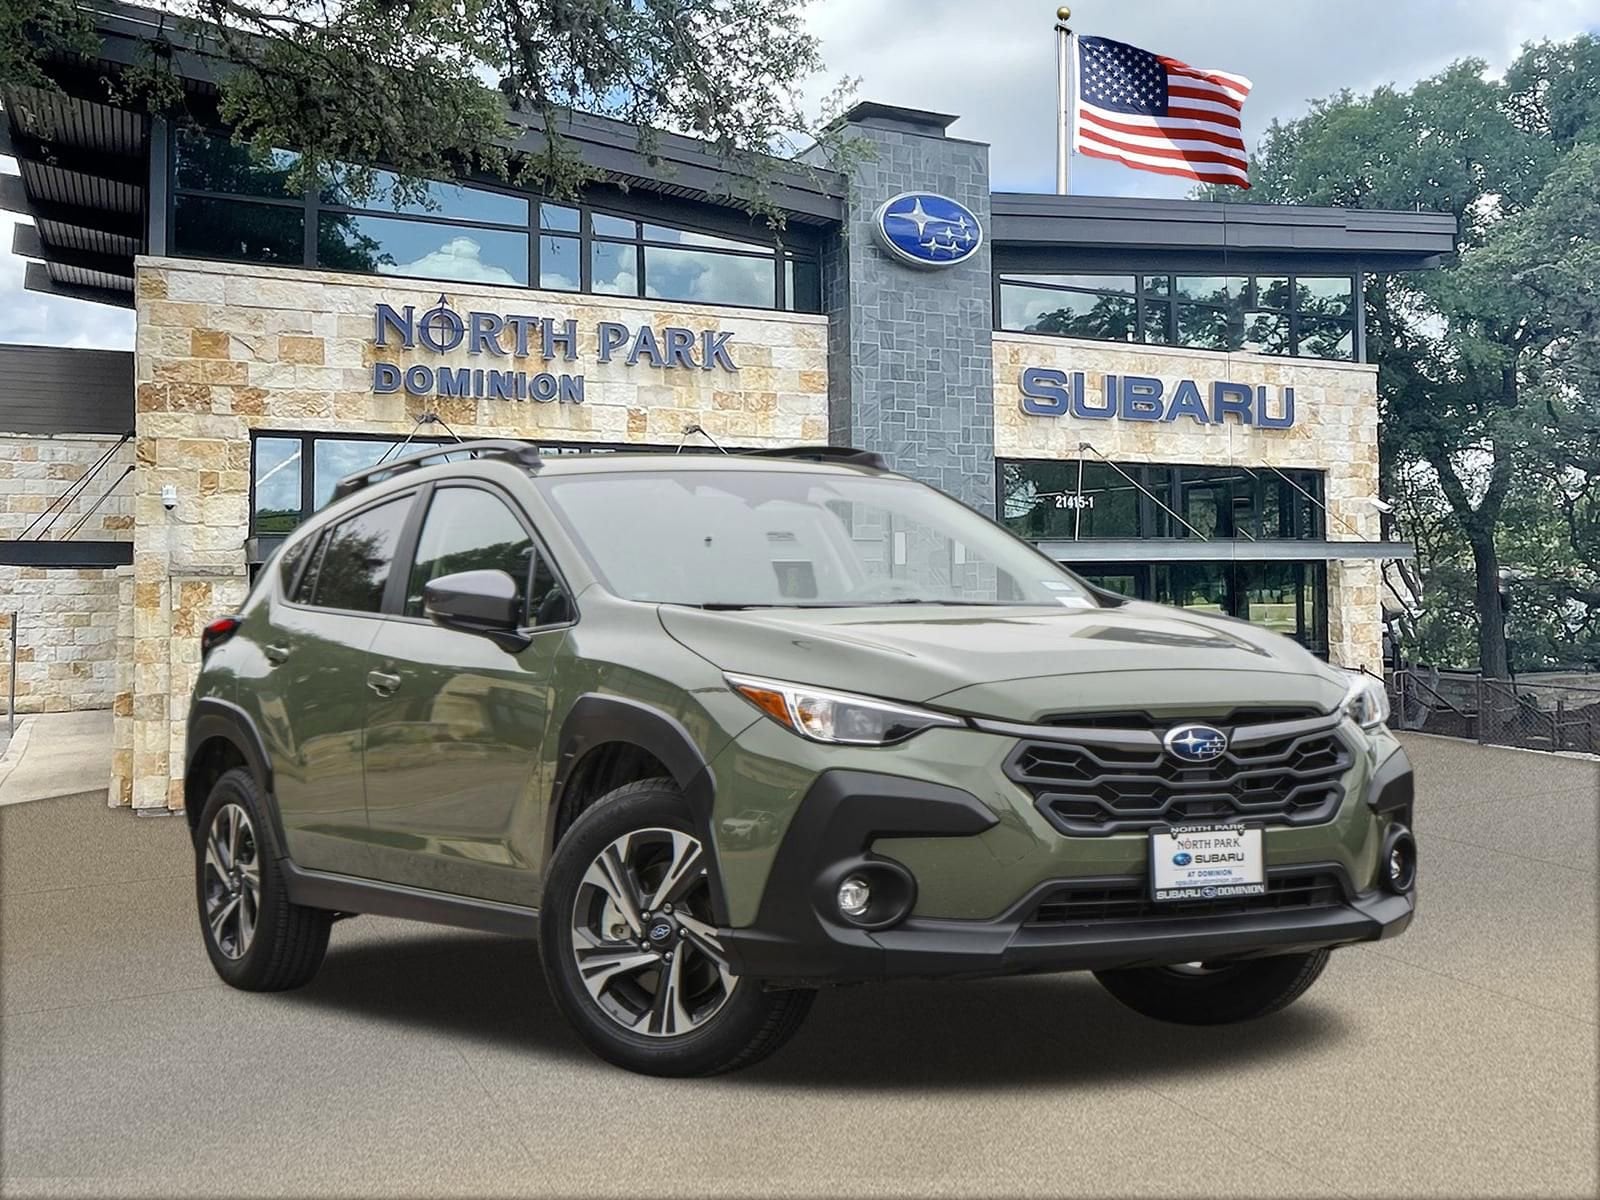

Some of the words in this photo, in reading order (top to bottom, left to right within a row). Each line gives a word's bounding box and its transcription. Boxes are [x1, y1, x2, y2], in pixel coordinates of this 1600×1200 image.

[374, 293, 580, 362] NORTH
[597, 320, 740, 372] PARK
[373, 361, 585, 404] DOMINION
[1019, 367, 1295, 430] SUBARU
[1170, 825, 1212, 834] NORTH
[1215, 823, 1246, 831] PARK
[1177, 838, 1211, 850] NORTH
[1213, 838, 1241, 848] PARK
[1195, 853, 1245, 864] SUBARU
[1187, 870, 1196, 878] AT
[1197, 869, 1233, 877] DOMINION
[1156, 890, 1201, 900] SUBARU
[1217, 884, 1265, 896] DOMINION
